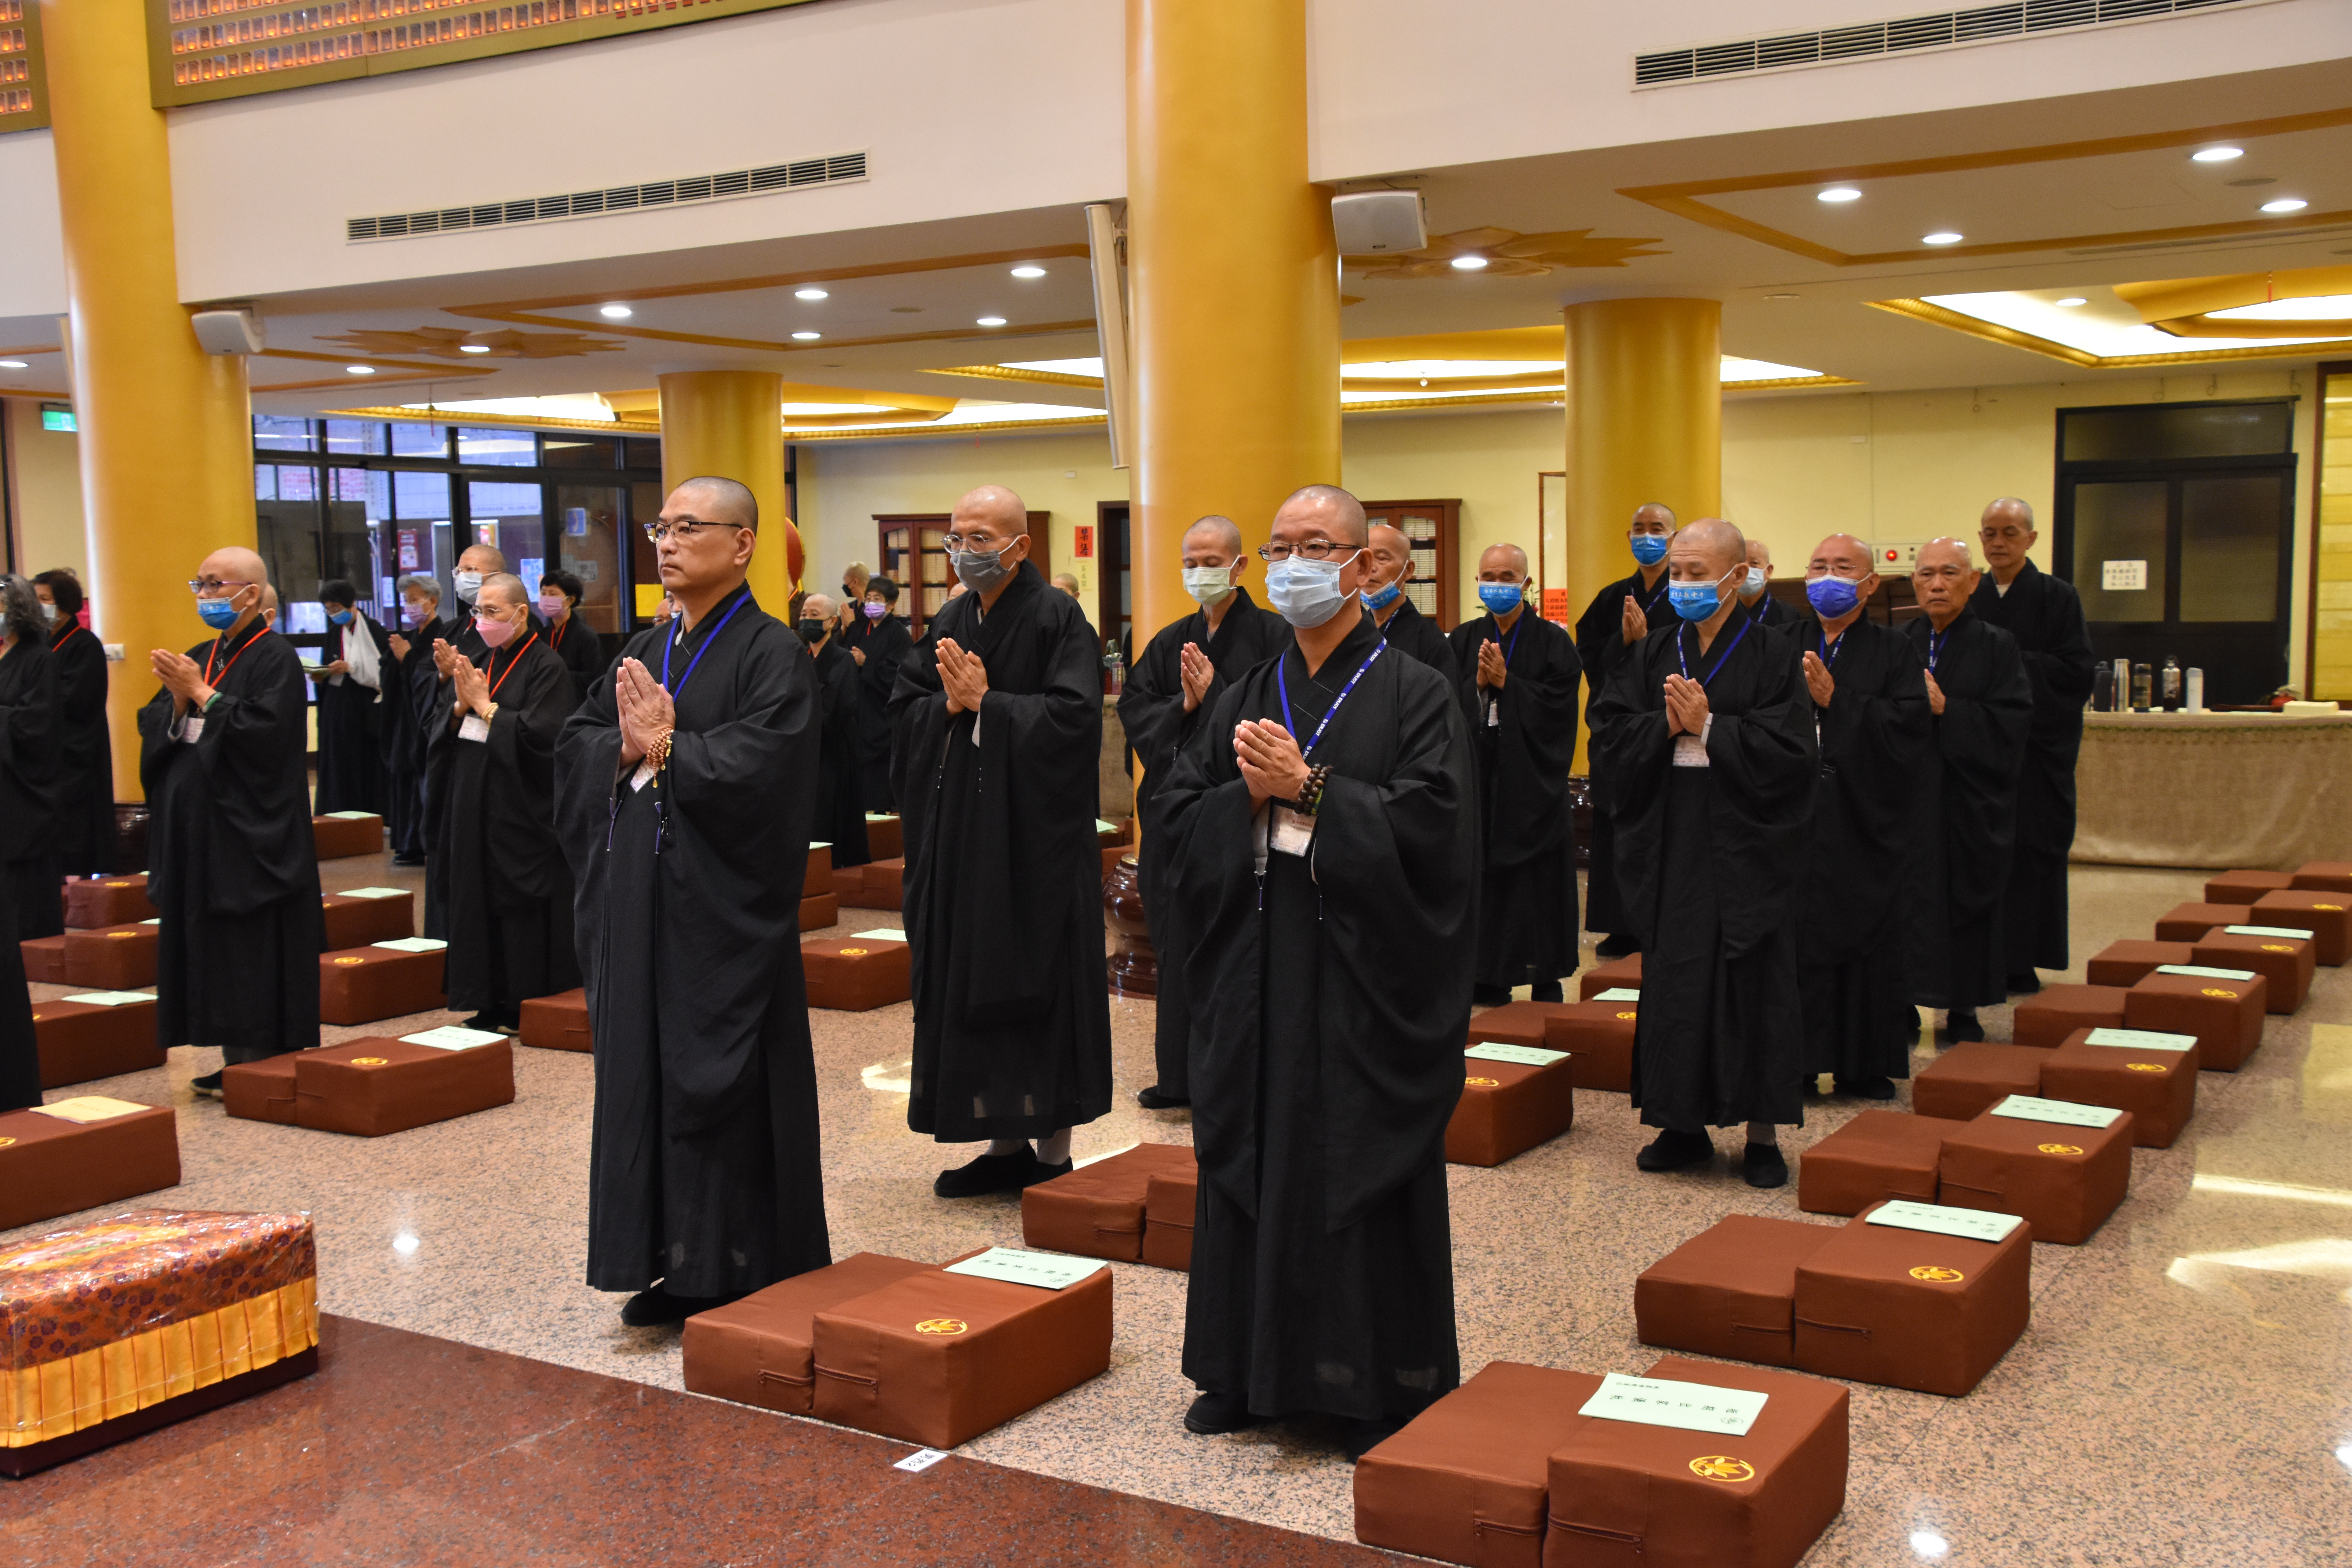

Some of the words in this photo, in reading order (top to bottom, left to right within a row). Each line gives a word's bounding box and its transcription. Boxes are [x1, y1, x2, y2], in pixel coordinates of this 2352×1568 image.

[1369, 652, 1378, 662] ENJOY
[1351, 672, 1361, 684] ENJOY
[1333, 697, 1343, 710] ENJOY
[1316, 723, 1325, 736] ENJOY
